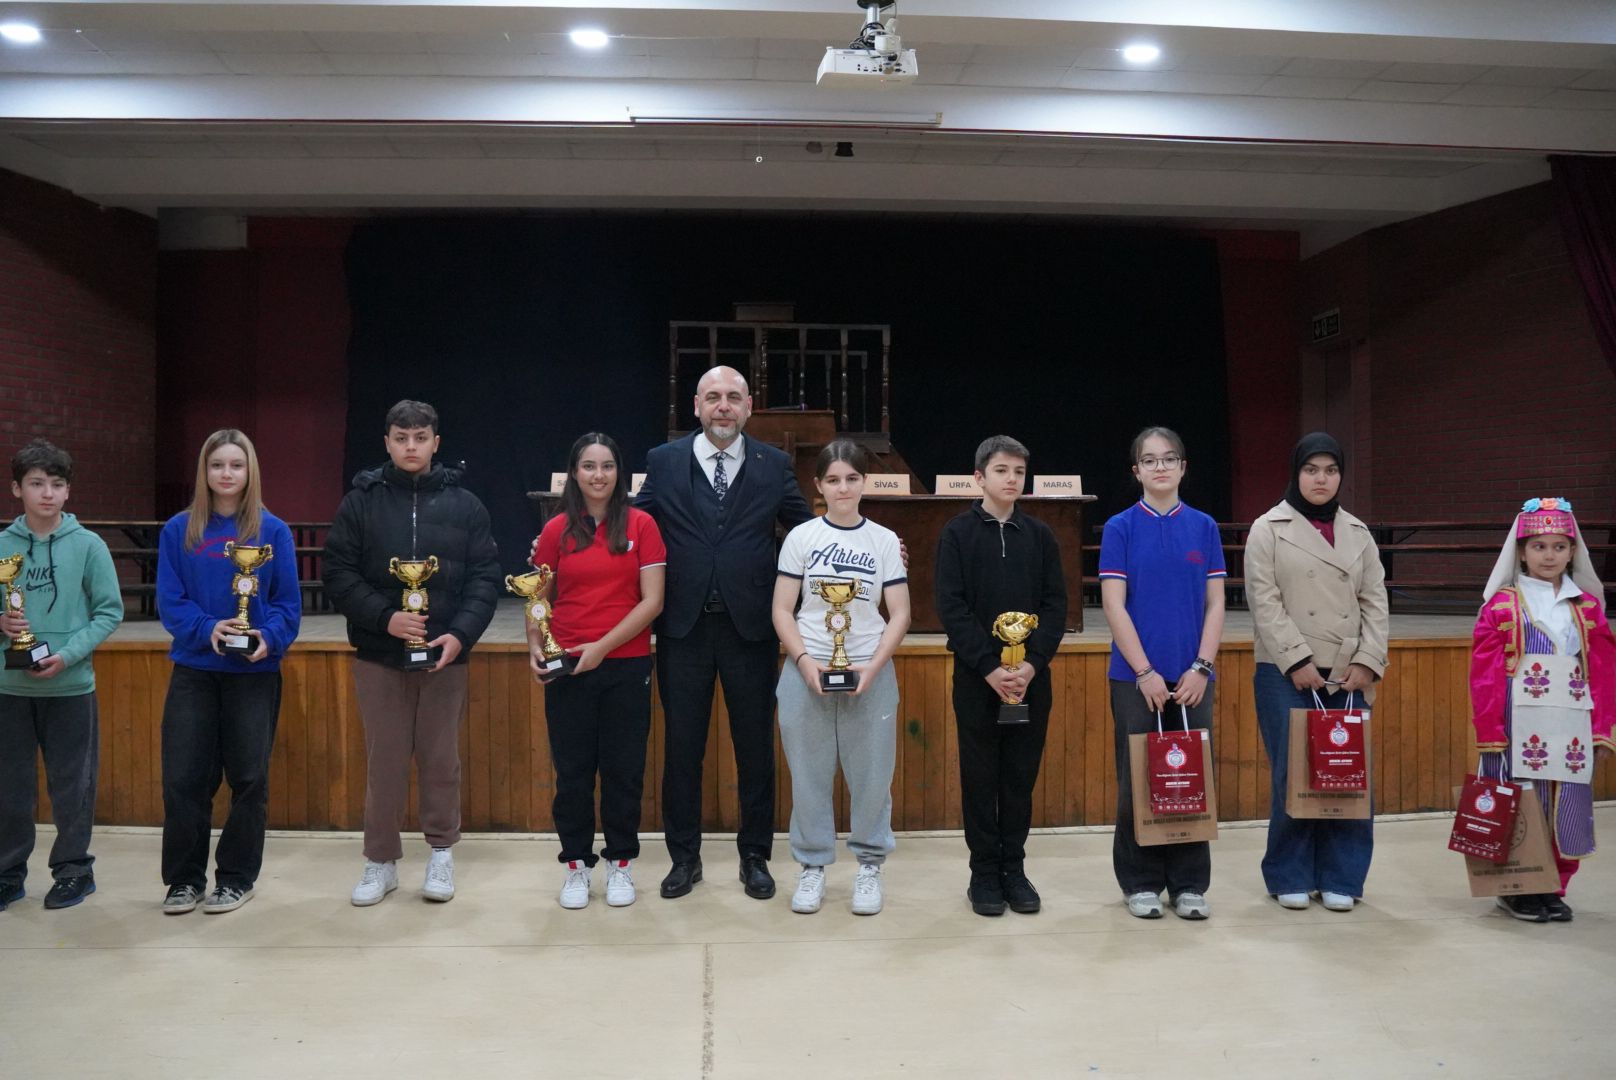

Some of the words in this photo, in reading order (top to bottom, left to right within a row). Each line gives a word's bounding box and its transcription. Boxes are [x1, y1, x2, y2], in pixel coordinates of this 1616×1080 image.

[874, 480, 899, 489] SİVAS
[1043, 481, 1073, 489] MARAŞ
[807, 542, 876, 570] Athletic
